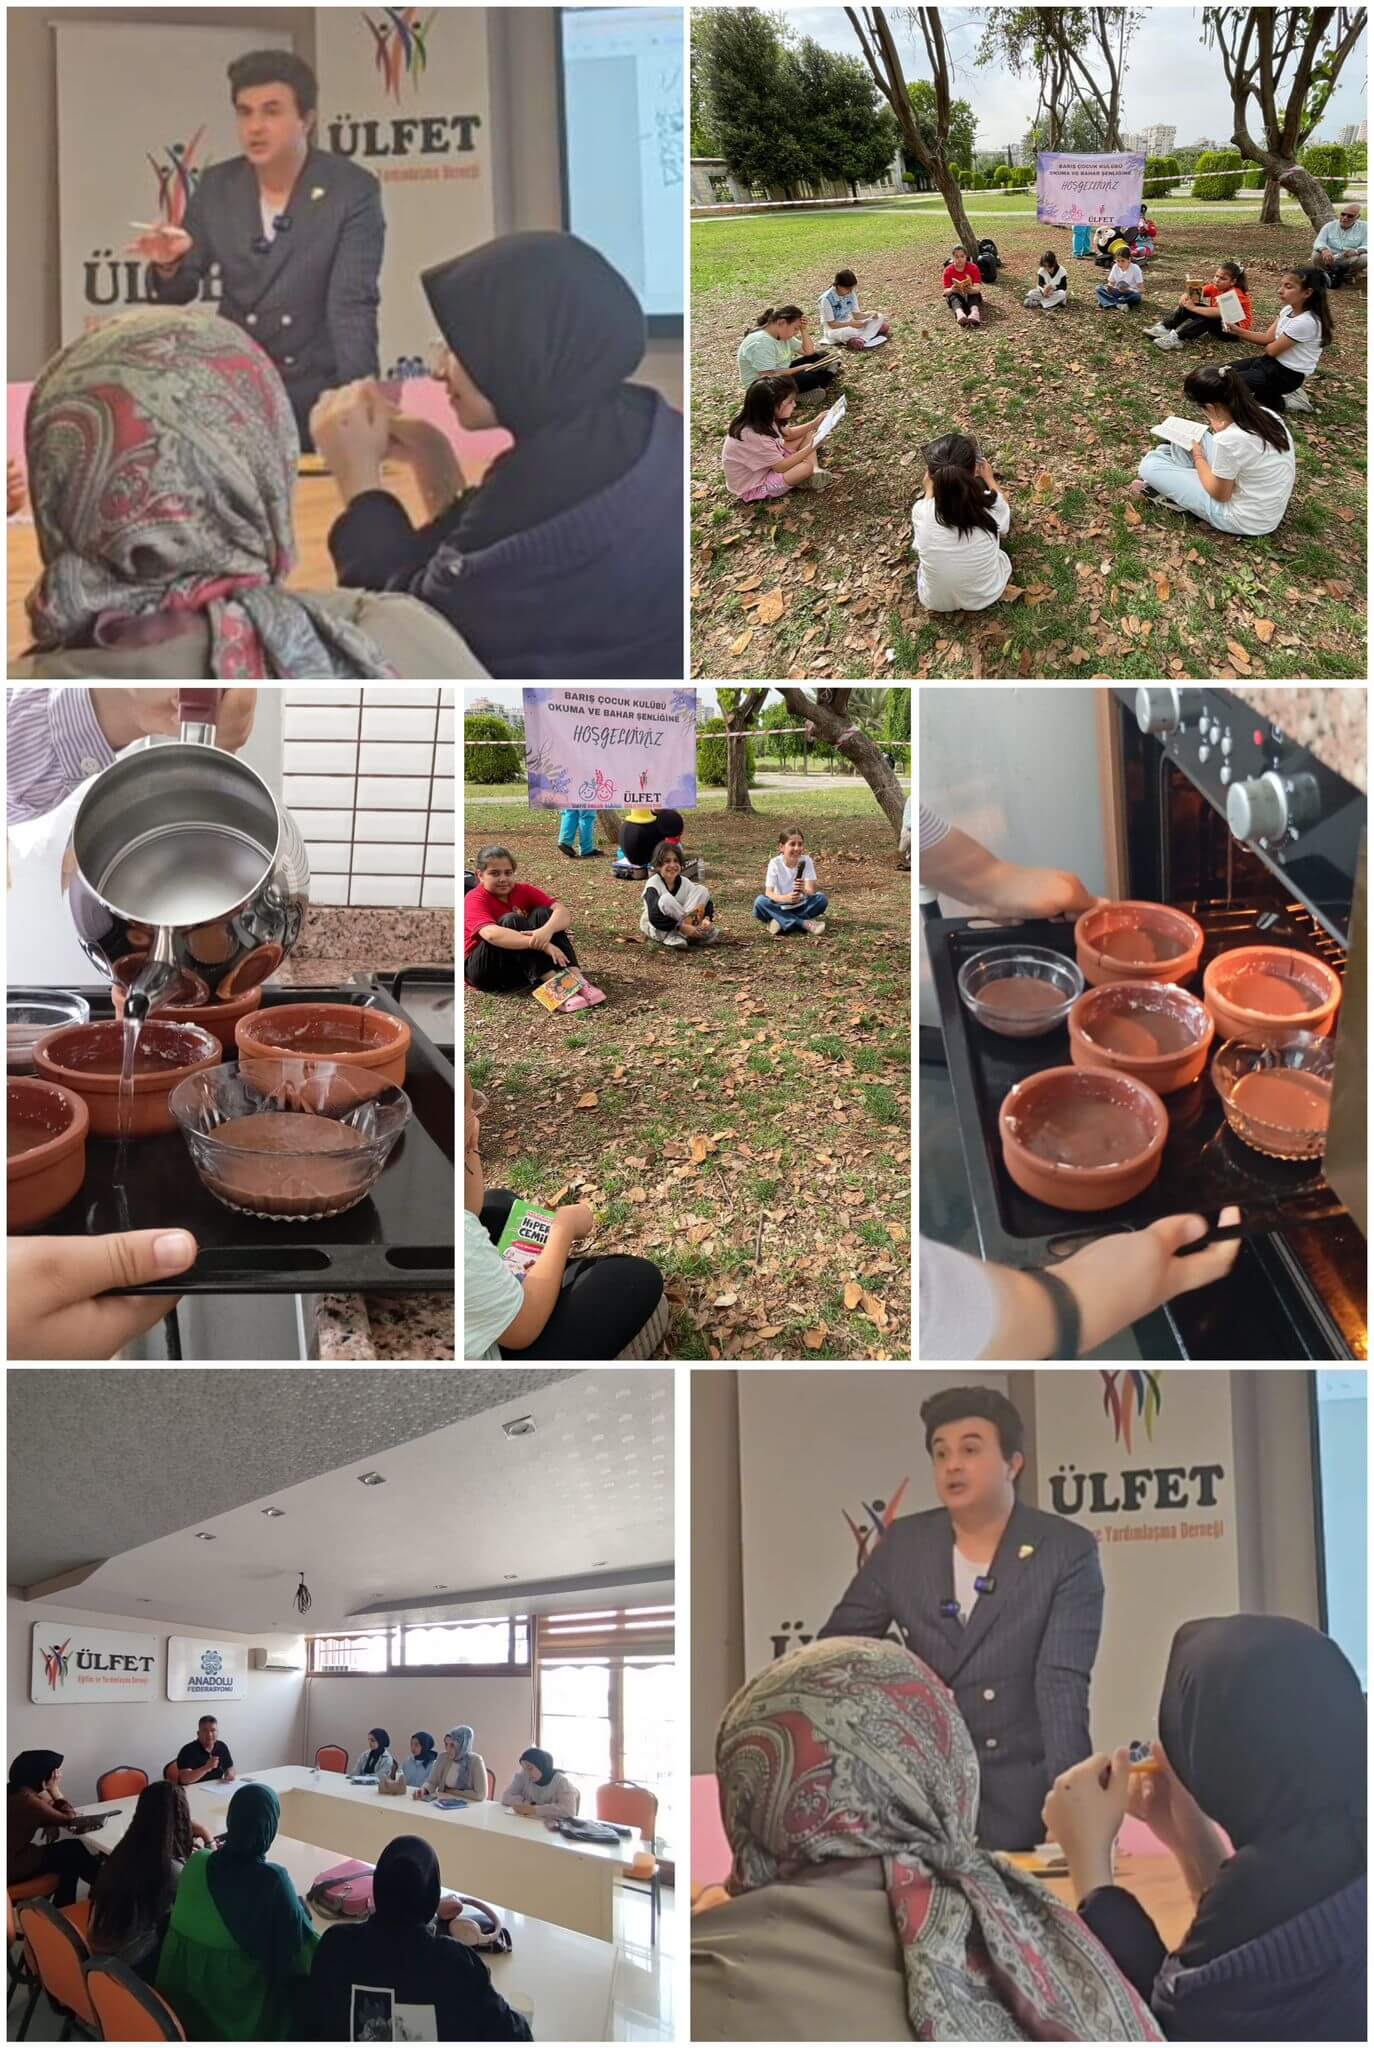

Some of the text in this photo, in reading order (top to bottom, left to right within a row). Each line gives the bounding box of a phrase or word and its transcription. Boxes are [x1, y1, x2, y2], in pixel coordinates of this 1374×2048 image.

[328, 114, 481, 157] ÜLFET
[1088, 215, 1115, 223] ÜLFET
[564, 691, 667, 710] BARIŞ ÇOCUK KULÜBÜ
[547, 703, 680, 723] OKUMA VE BAHAR ŞENLİĞİNE
[573, 725, 665, 749] HOŞGELDİNİZ
[623, 790, 662, 803] ÜLFET
[1048, 1464, 1224, 1515] ÜLFET
[1104, 1519, 1178, 1544] Yardımlaşma
[1180, 1519, 1224, 1542] Derneği
[76, 1648, 155, 1672] ÜLFET
[188, 1676, 233, 1686] ANADOLU
